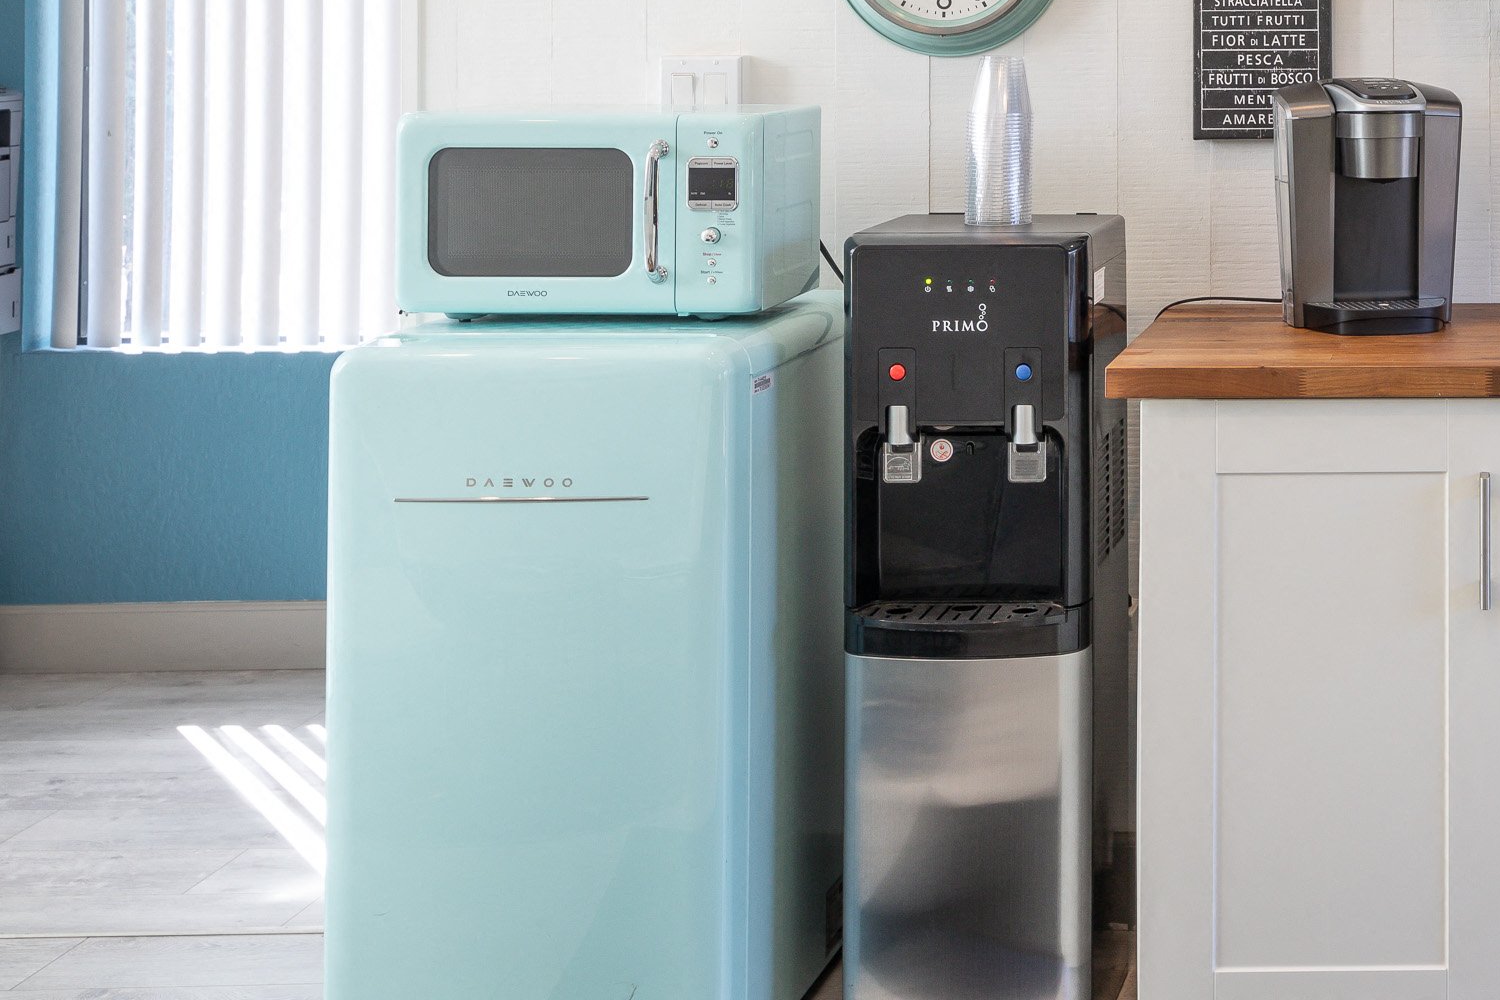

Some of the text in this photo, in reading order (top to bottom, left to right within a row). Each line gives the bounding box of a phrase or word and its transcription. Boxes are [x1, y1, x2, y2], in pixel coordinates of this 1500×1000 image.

[1212, 15, 1305, 26] TUTTI FRUTTI
[1212, 35, 1306, 46] FIOR DI LATTE
[1237, 54, 1283, 65] PESCA
[1208, 73, 1253, 85] FRUTTI
[1271, 72, 1313, 85] BOSCO
[1234, 94, 1273, 105] MENT
[1222, 113, 1274, 125] AMARE
[932, 320, 988, 332] PRIMO
[466, 478, 573, 488] DAEWOO
